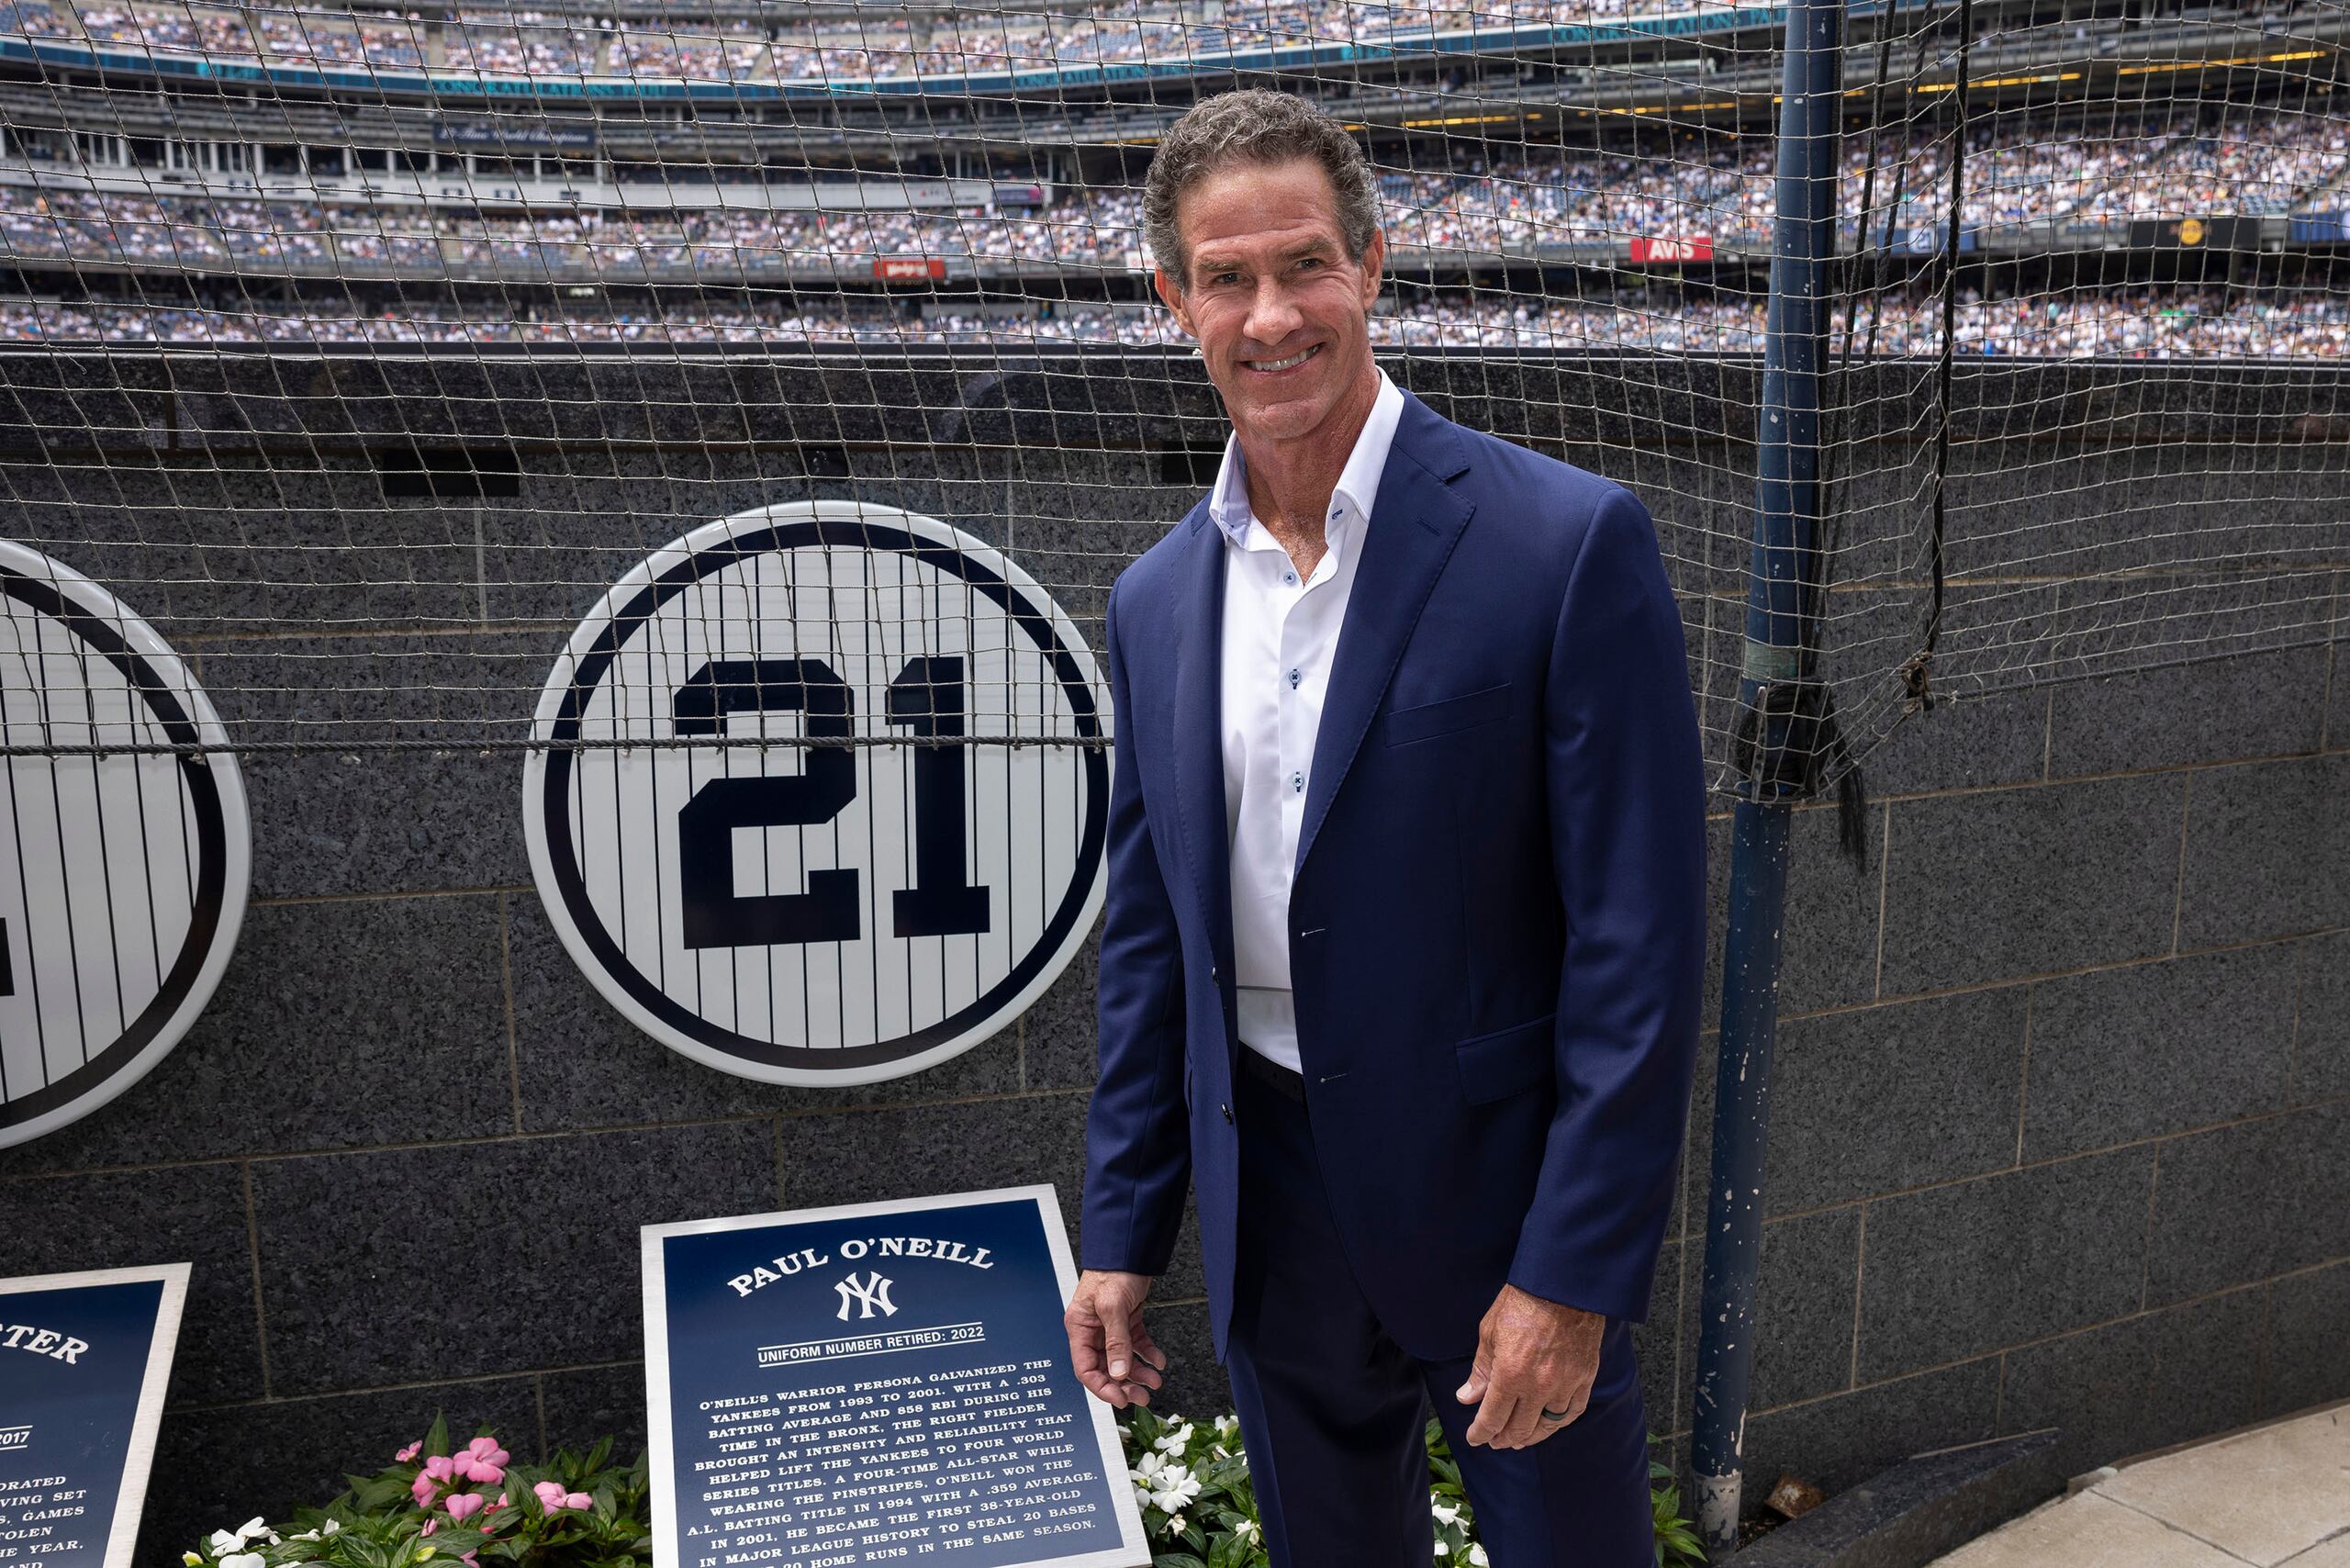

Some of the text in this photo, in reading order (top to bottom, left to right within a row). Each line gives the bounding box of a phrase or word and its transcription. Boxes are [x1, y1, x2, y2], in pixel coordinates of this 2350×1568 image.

[1649, 237, 1695, 260] AVIS
[674, 656, 990, 949] 21
[726, 1237, 993, 1297] PAUL O'NEILL
[0, 1323, 89, 1365] TER
[757, 1326, 984, 1362] UNIFORM NUMBER RETIRED: 2022
[699, 1359, 1052, 1410] O'NEILL'S WARRIOR PERSONA GALVANIZED THE
[711, 1407, 780, 1424] YANKEES
[788, 1401, 831, 1414] FROM
[839, 1395, 874, 1407] 1993
[880, 1393, 901, 1402] TO
[952, 1381, 991, 1393] WITH
[999, 1379, 1009, 1387] A
[1016, 1374, 1046, 1385] .303
[708, 1387, 1052, 1439] BATTING AVERAGE AND 858 RBI DURING HIS
[719, 1439, 757, 1452] TIME
[765, 1437, 781, 1447] IN
[789, 1432, 820, 1443] THE
[891, 1419, 922, 1430] THE
[929, 1412, 976, 1425] RIGHT
[983, 1403, 1046, 1418] FIELDER
[694, 1414, 1072, 1471] BROUGHT AN INTENSITY AND RELIABILITY THAT
[709, 1430, 1064, 1484] HELPED LIFT THE YANKEES TO FOUR WORLD
[702, 1443, 1074, 1501] SERIES TITLES. A FOUR-TIME ALL-STAR WHILE
[710, 1498, 785, 1516] WEARING
[792, 1493, 824, 1505] THE
[935, 1470, 995, 1485] O'NEILL
[1002, 1464, 1035, 1476] WON
[1042, 1459, 1072, 1471] THE
[0, 1489, 87, 1507] VING SET
[22, 1506, 84, 1521] GAMES
[687, 1472, 1097, 1536] A.L. BATTING TITLE IN 1994 WITH A .359 AVERAGE.
[711, 1539, 727, 1550] IN
[786, 1528, 808, 1539] HE
[815, 1518, 879, 1534] BECAME
[887, 1512, 918, 1524] THE
[926, 1505, 972, 1518] FIRST
[979, 1489, 1080, 1511] 38-YEAR-OLD
[29, 1540, 84, 1554] YEAR.
[699, 1503, 1096, 1568] IN MAJOR LEAGUE HISTORY TO STEAL 20 BASES
[810, 1554, 856, 1568] HOME
[865, 1547, 908, 1561] RUNS
[917, 1542, 934, 1553] IN
[943, 1537, 974, 1550] THE
[982, 1529, 1024, 1543] SAME
[1033, 1520, 1095, 1536] SEASON.
